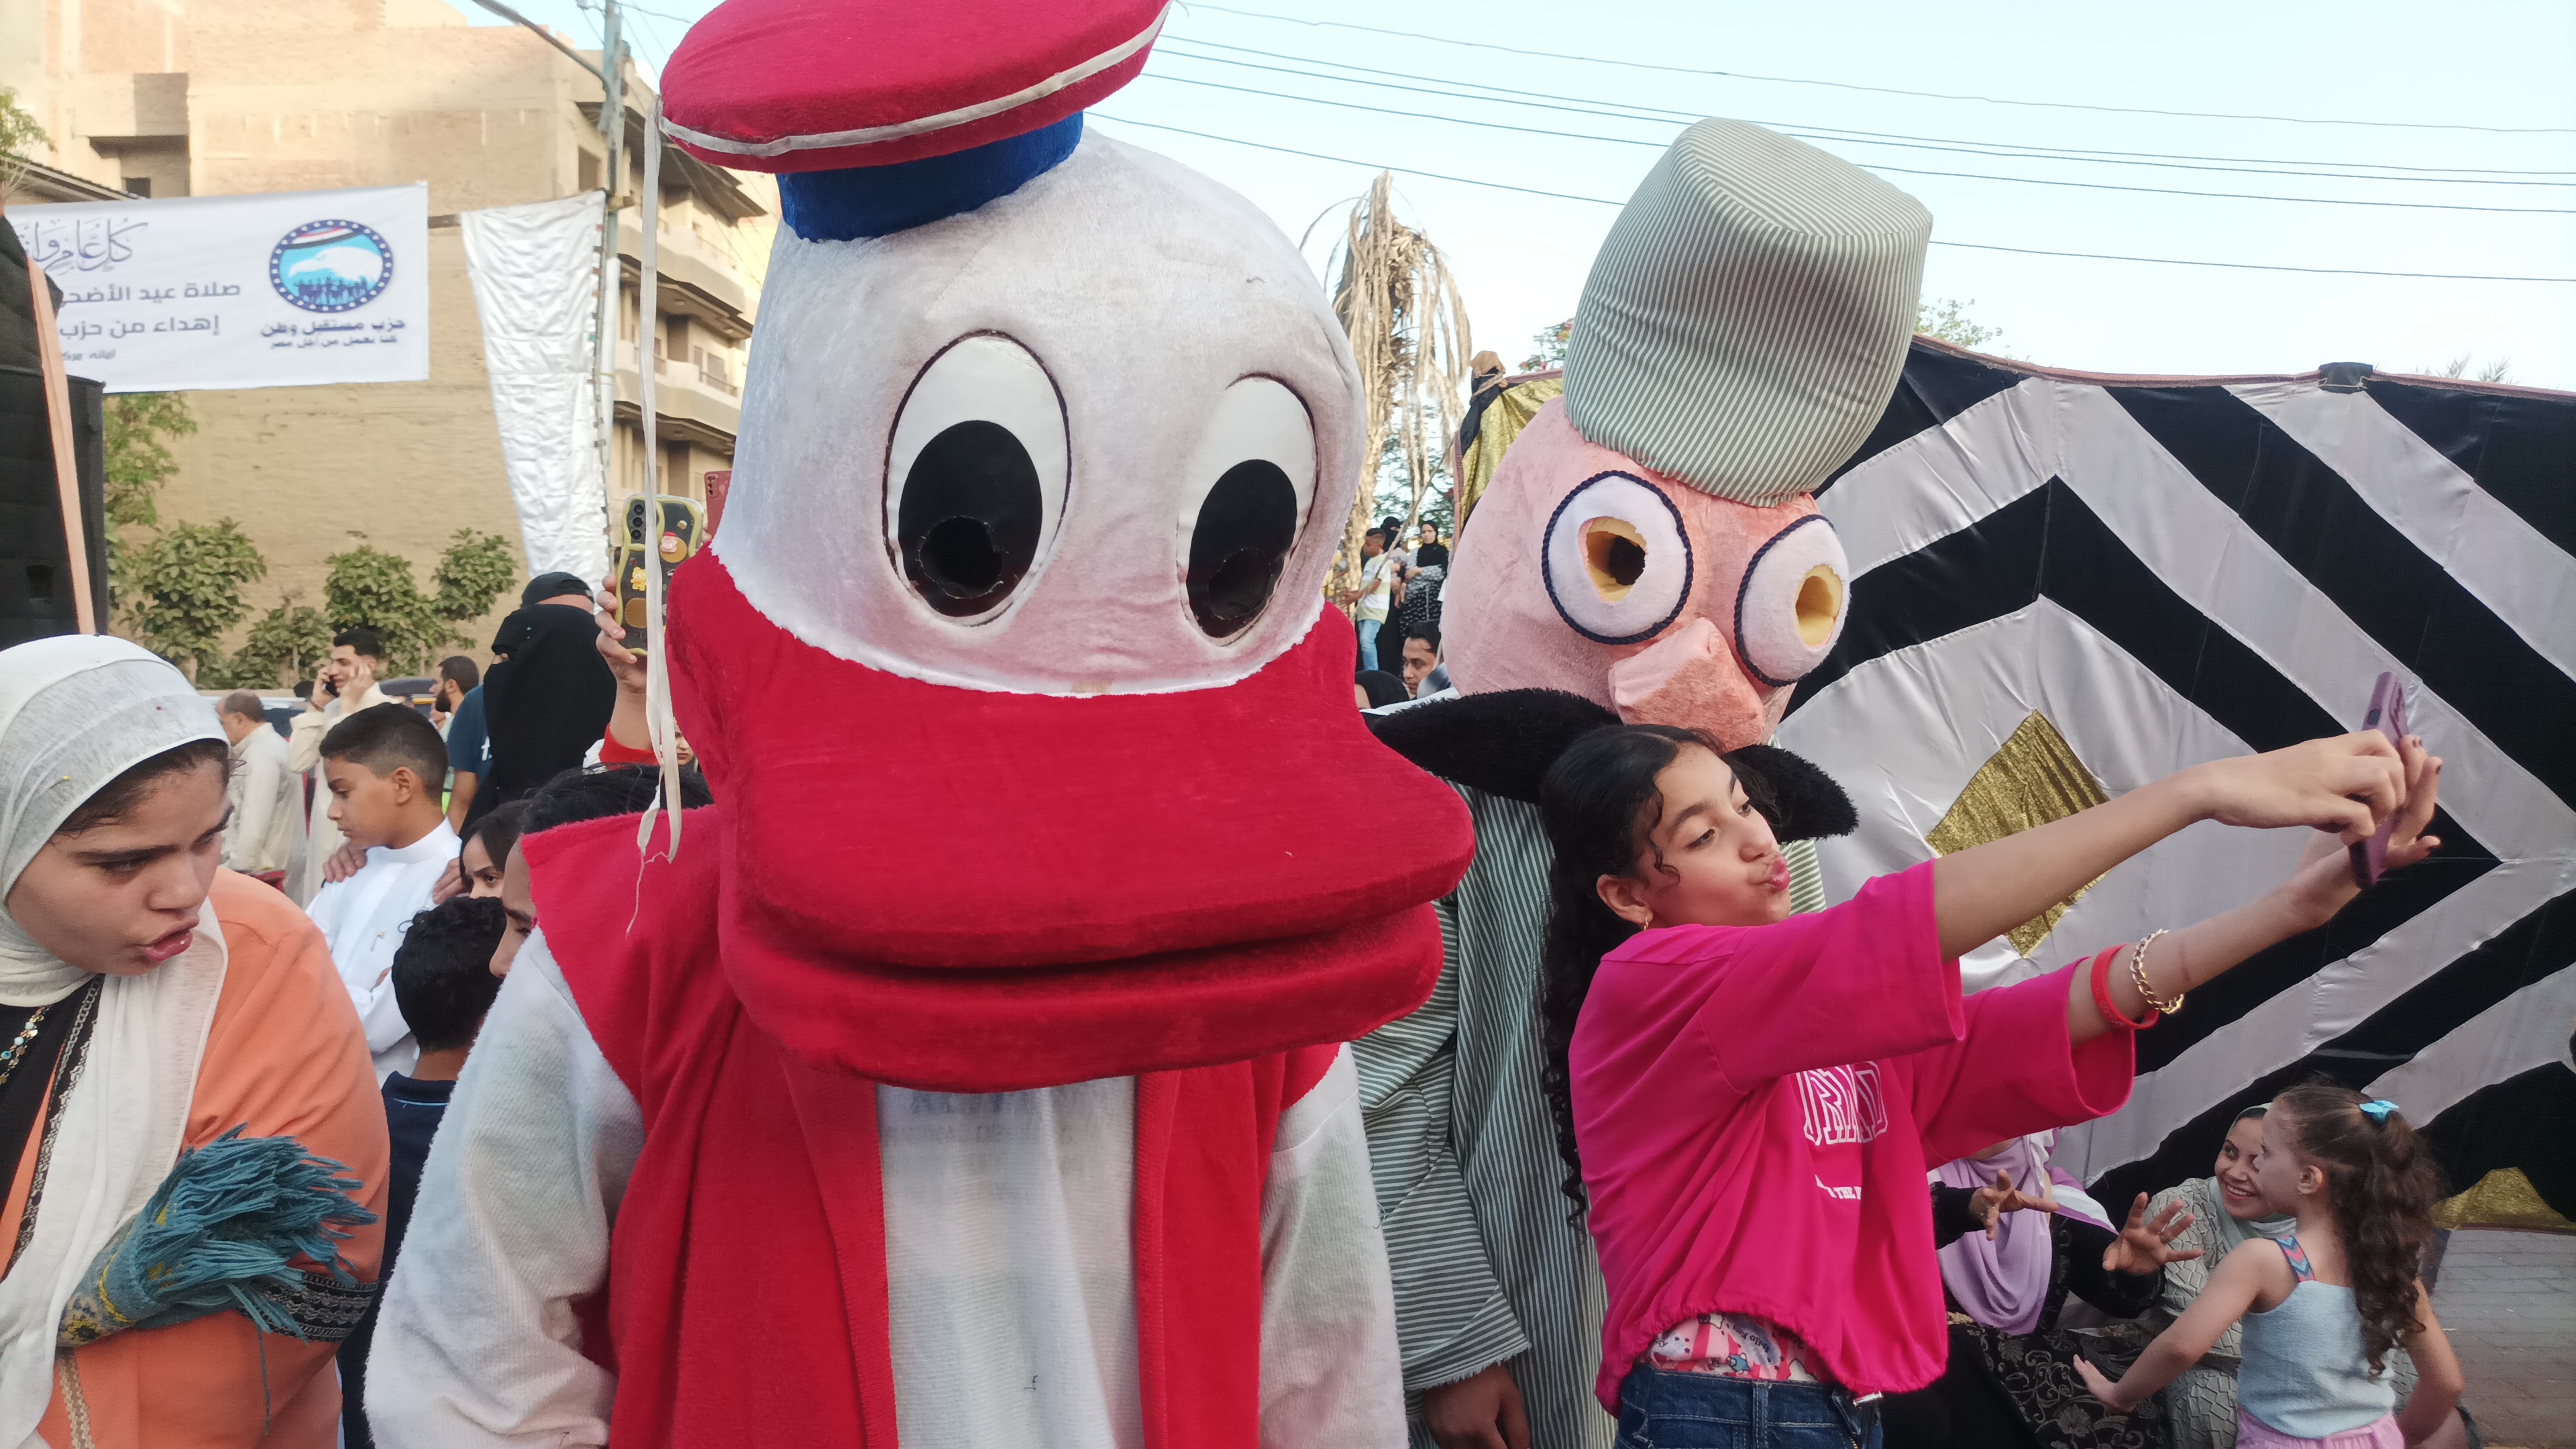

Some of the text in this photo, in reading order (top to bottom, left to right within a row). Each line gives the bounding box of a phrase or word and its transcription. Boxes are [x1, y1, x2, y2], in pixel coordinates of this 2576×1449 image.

[138, 286, 176, 303] عيد
[184, 281, 241, 299] صلاة
[59, 315, 220, 341] إهداء من حزب
[260, 315, 405, 337] حزب مستقبل وطن
[1833, 1186, 1856, 1200] THE
